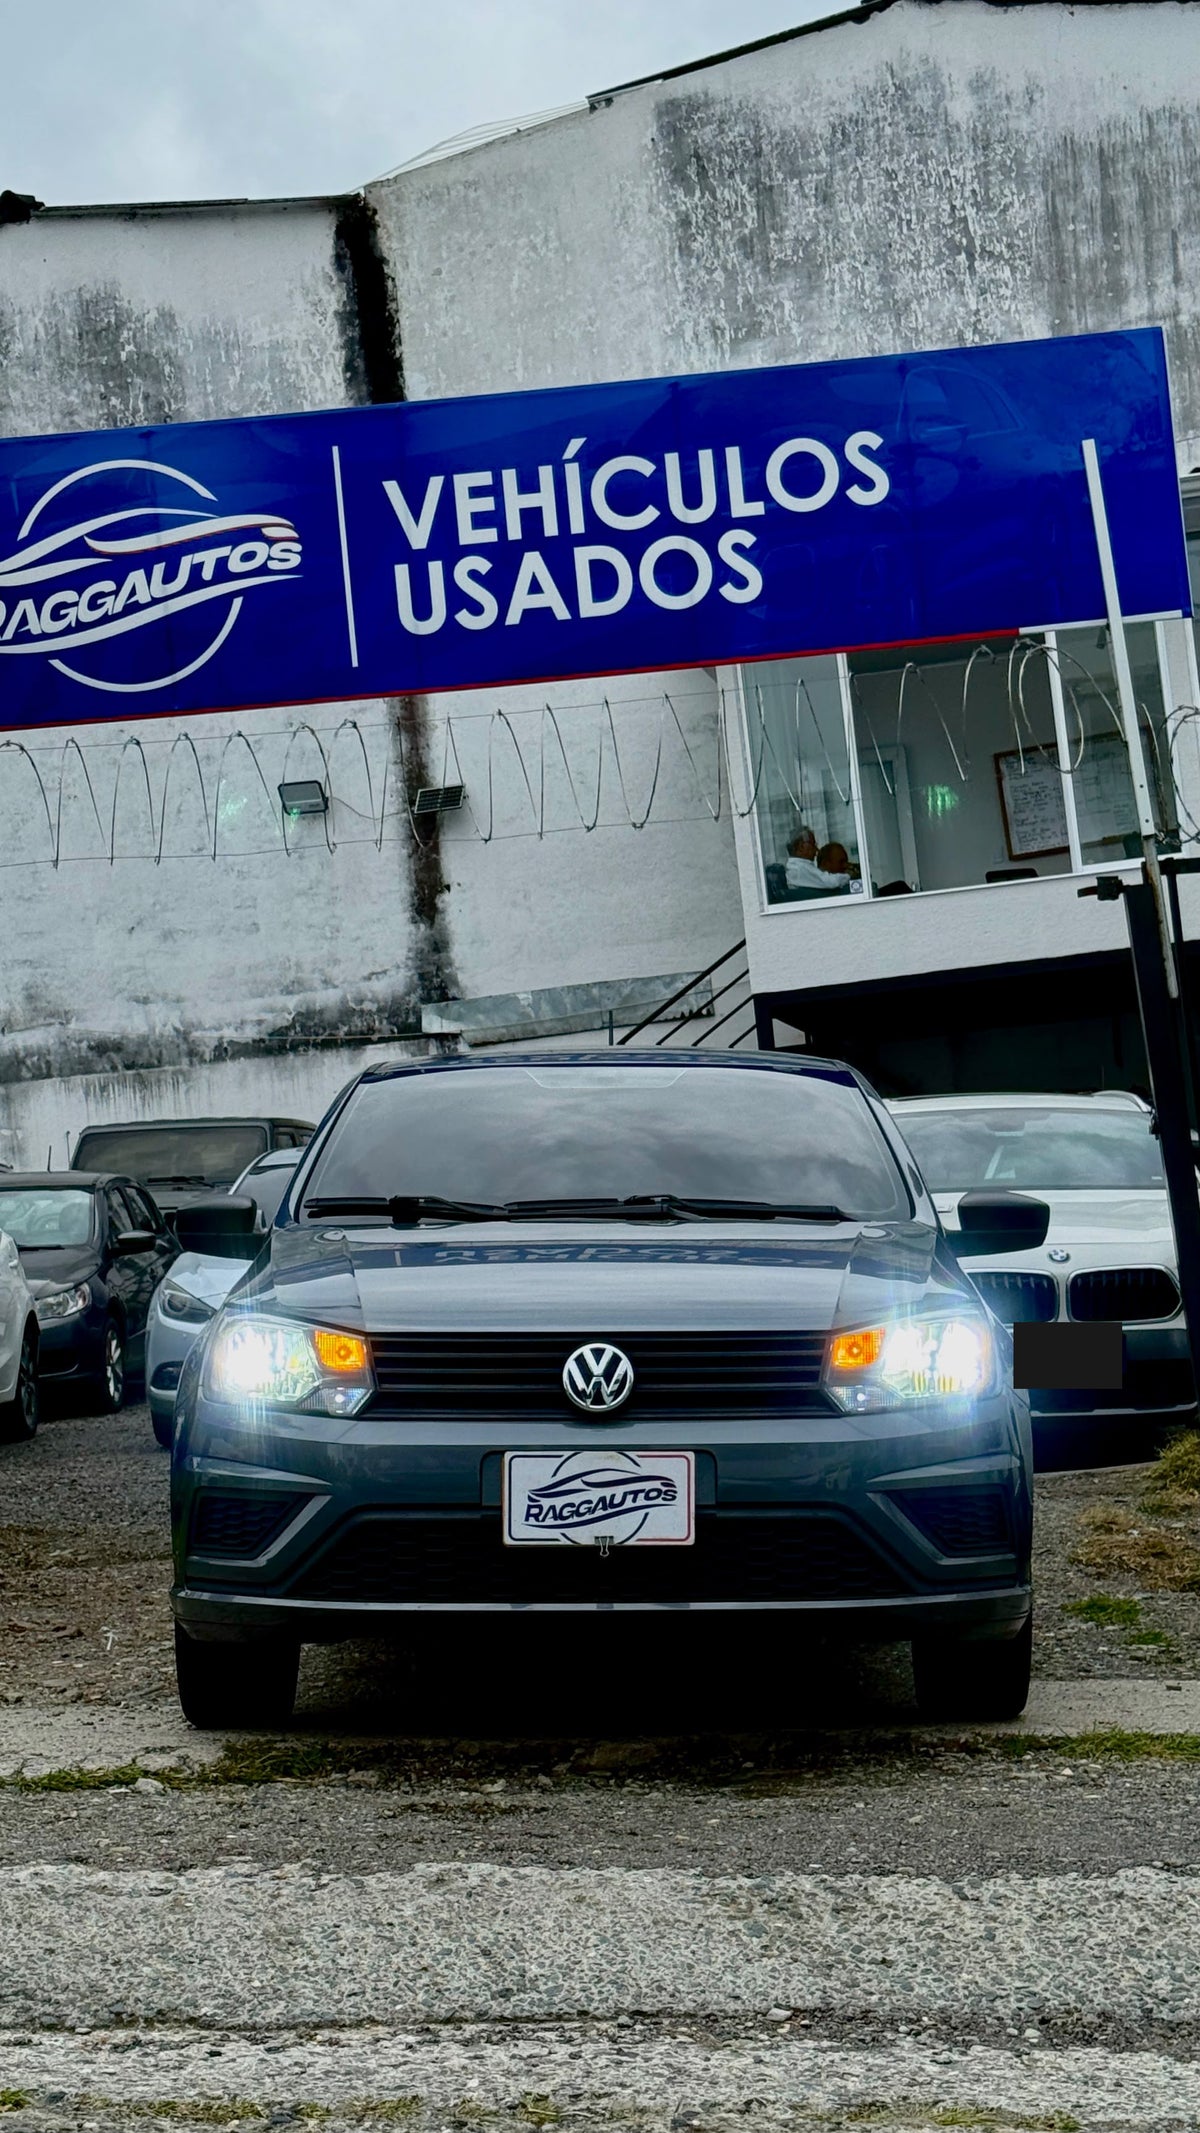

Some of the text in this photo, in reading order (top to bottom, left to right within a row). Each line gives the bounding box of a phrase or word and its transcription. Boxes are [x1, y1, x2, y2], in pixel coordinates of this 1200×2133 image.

[381, 431, 891, 550] VEHÍCULOS
[394, 529, 764, 636] USADOS
[523, 1487, 678, 1523] RAGGAUTOS
